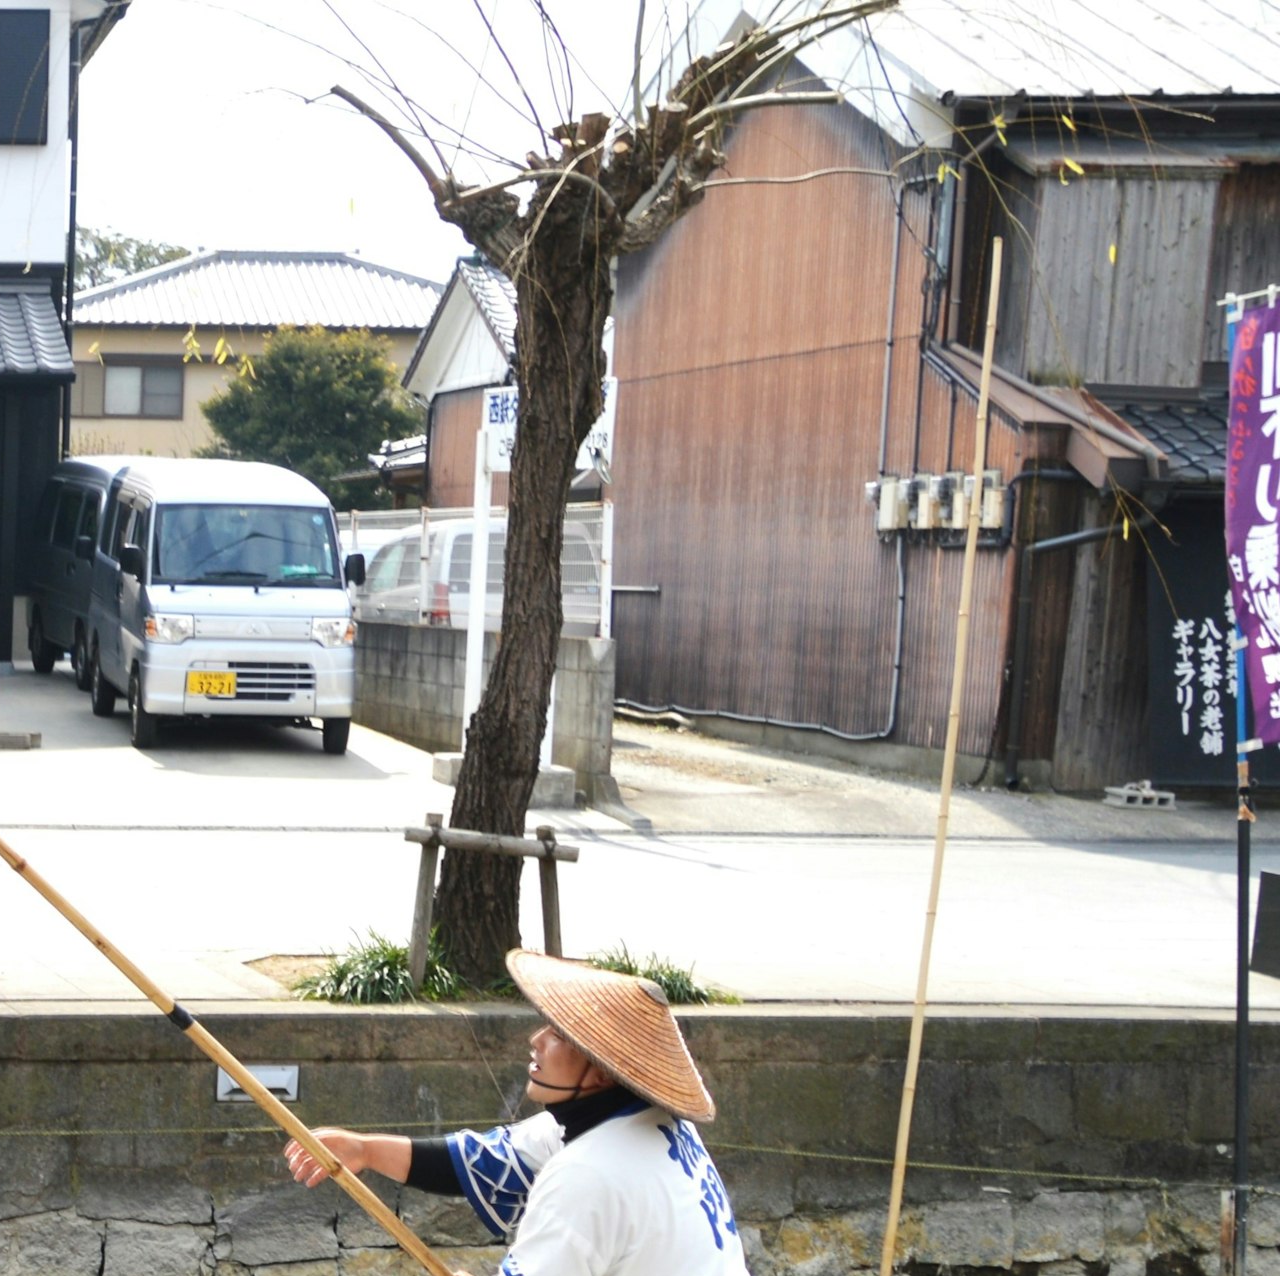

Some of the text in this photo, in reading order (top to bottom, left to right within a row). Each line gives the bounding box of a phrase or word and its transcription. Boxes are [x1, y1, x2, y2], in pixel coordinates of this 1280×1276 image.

[1172, 618, 1197, 736] ギャラリー
[1198, 617, 1224, 756] 八女茶の老舗
